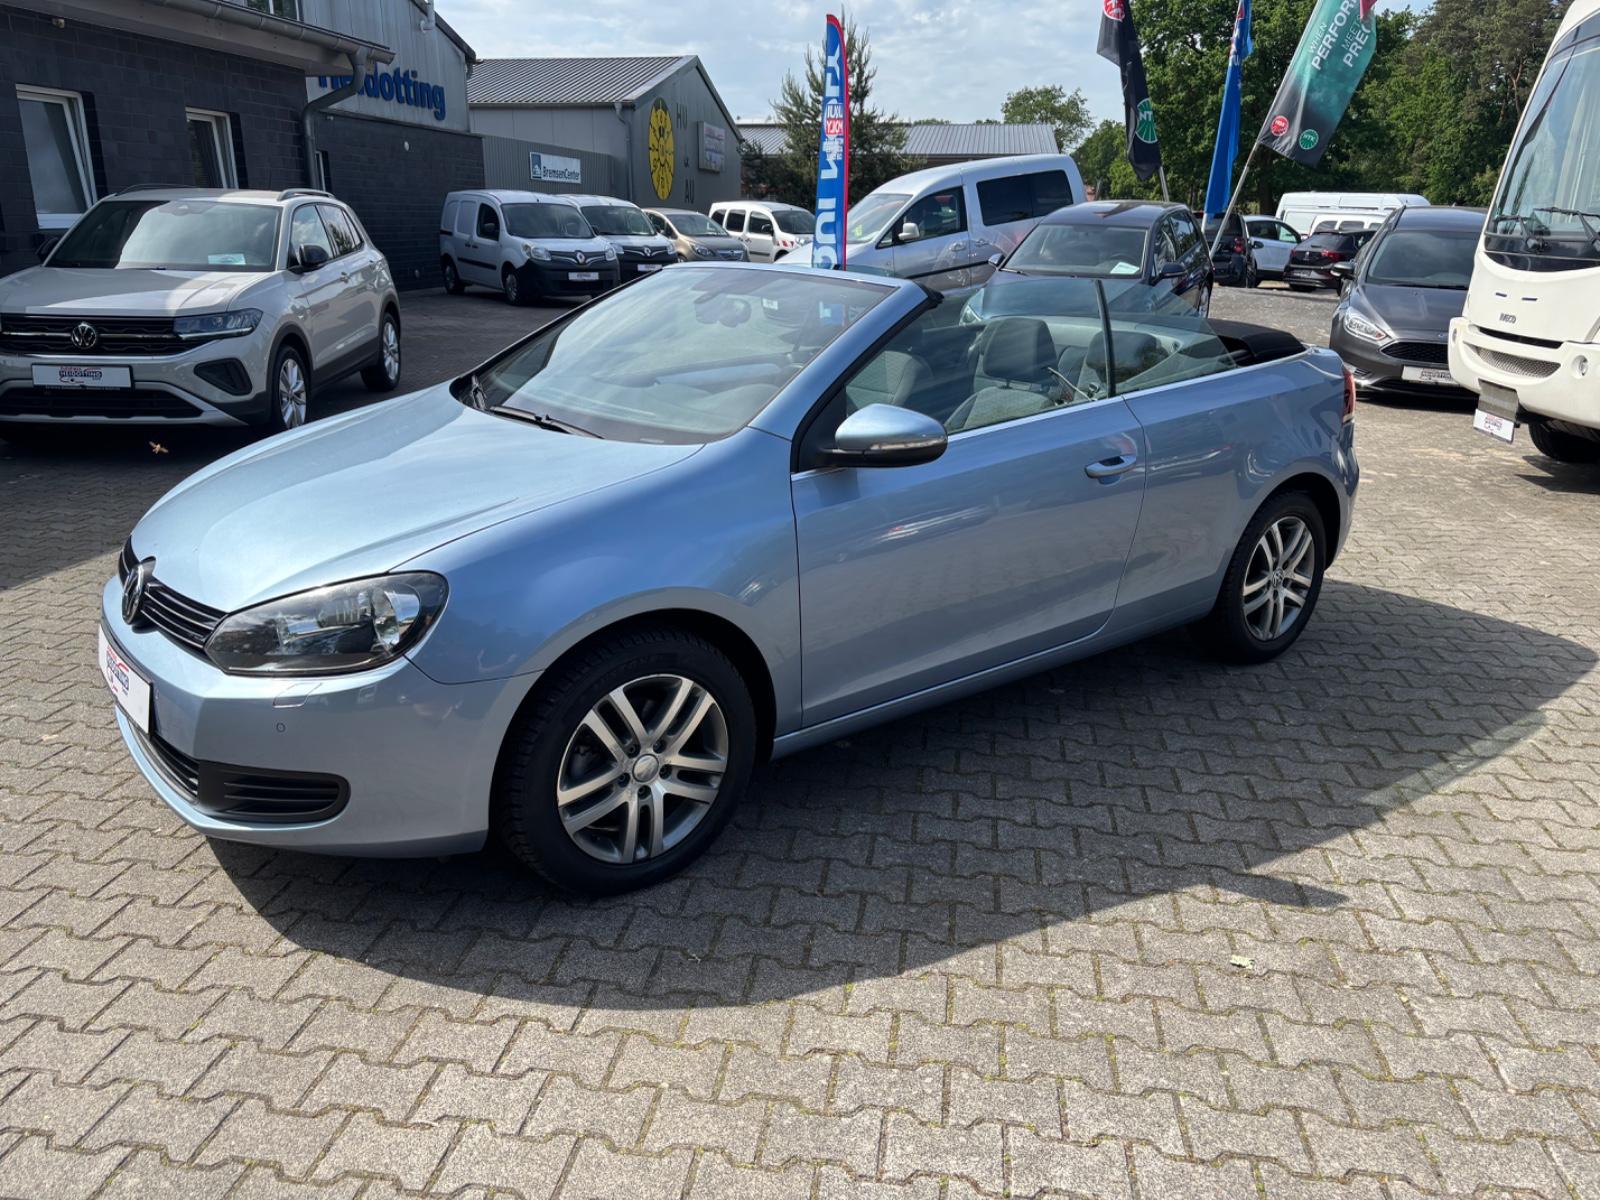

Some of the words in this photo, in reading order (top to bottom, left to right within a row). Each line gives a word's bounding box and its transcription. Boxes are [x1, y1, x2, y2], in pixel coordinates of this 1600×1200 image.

[1308, 23, 1328, 53] WHEN
[1312, 0, 1357, 70] PERFOR
[319, 62, 446, 121] dotting
